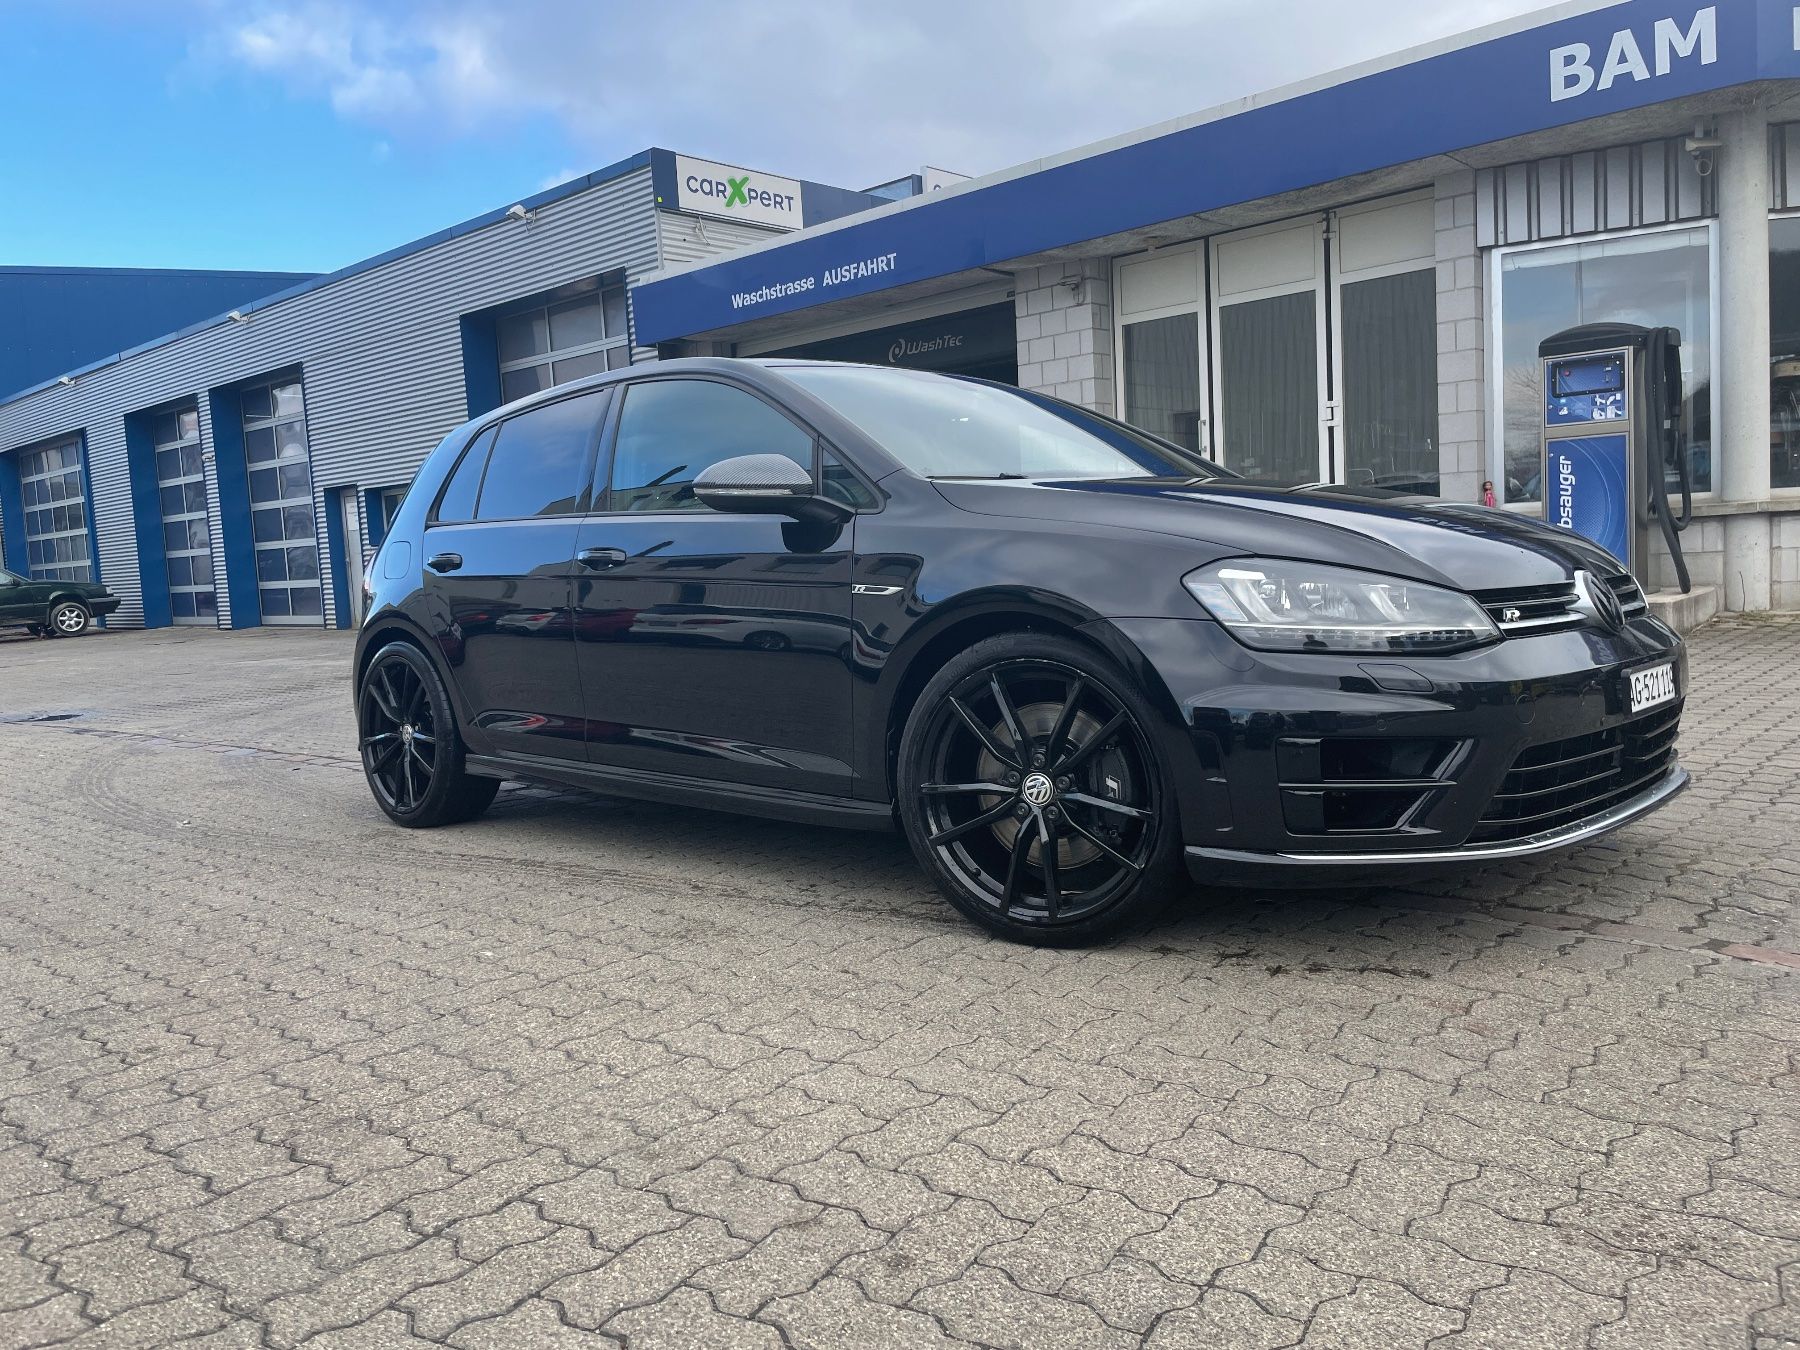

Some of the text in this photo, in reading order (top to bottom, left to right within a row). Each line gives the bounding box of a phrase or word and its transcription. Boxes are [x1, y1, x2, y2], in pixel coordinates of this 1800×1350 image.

[1549, 6, 1718, 103] BAM
[731, 252, 897, 309] Waschstrasse AUSFAHRT
